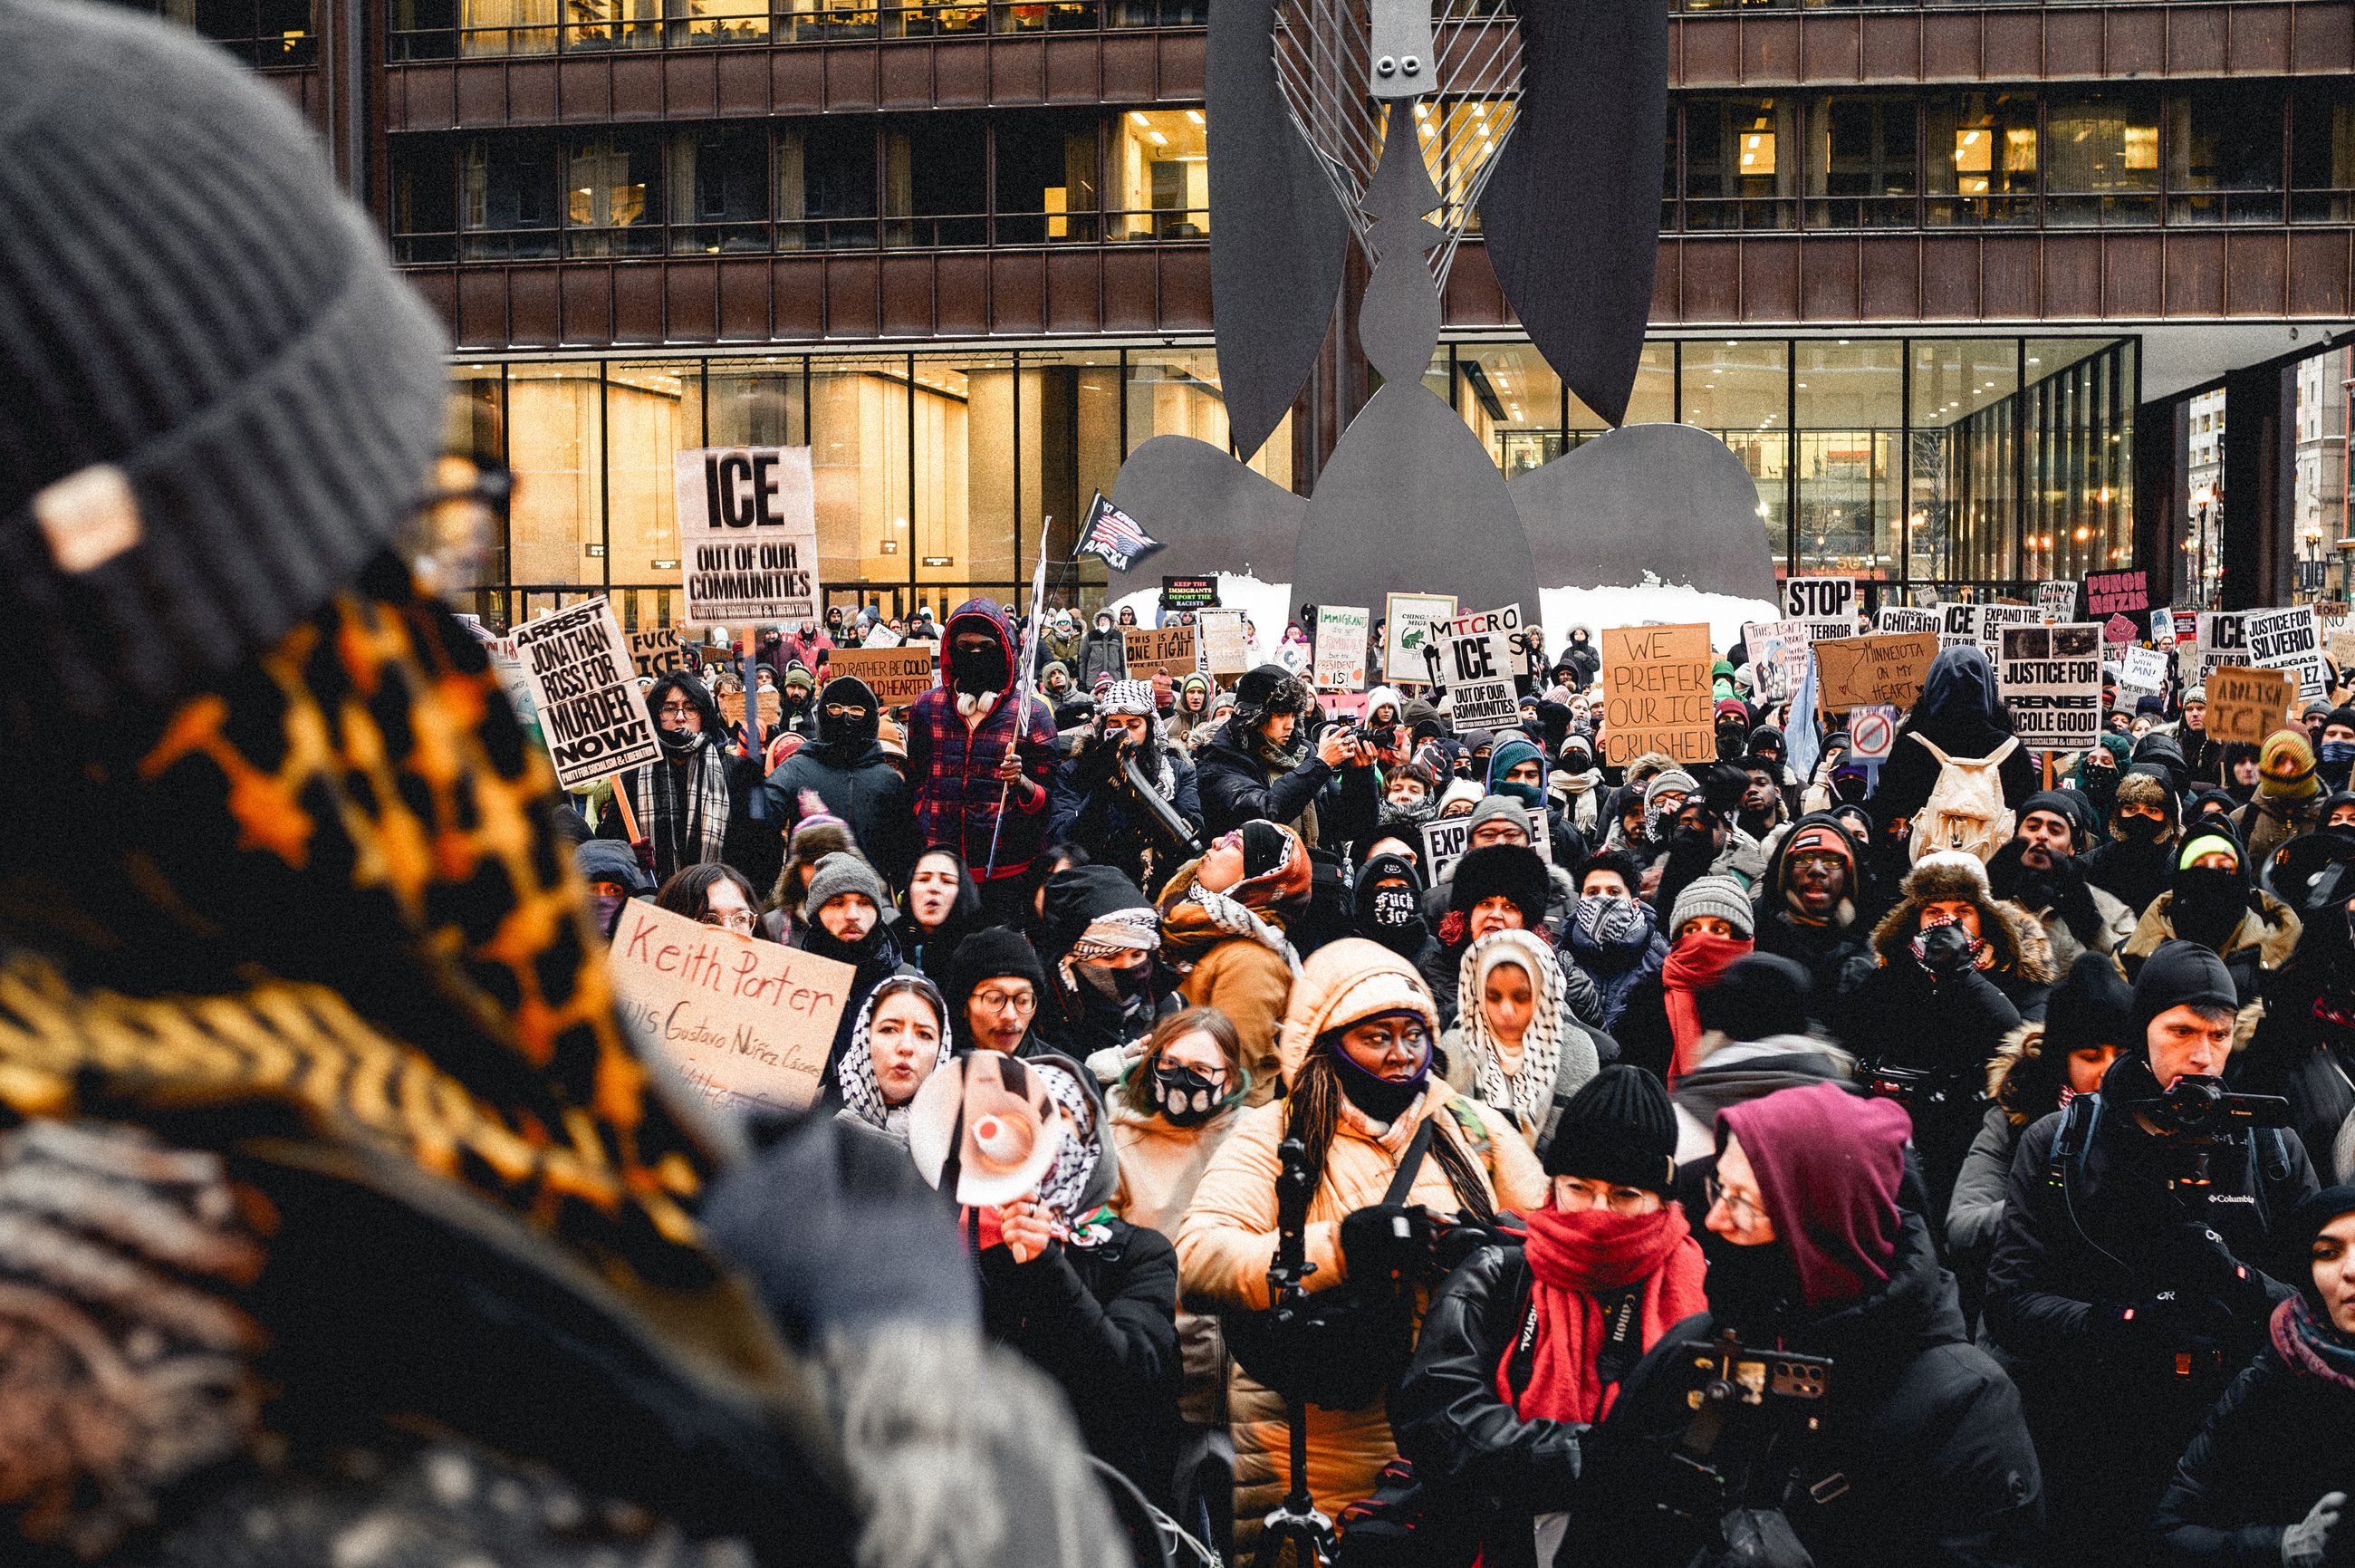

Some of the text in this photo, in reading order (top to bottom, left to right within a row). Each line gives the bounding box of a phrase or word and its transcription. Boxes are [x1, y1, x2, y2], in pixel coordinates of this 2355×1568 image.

[705, 451, 785, 528] ICE
[697, 541, 798, 572] OUT OF OUR
[688, 570, 812, 601] COMMUNITIES
[2040, 584, 2075, 596] THINK
[2087, 571, 2147, 595] PUNCH
[1789, 581, 1851, 616] STOP
[2088, 591, 2149, 615] NAZIS
[2323, 605, 2345, 615] OUT
[691, 603, 811, 620] PARTY FOR SOCIALISM & LIBERATION
[1882, 611, 1941, 632] CHICAGO
[1944, 605, 1975, 634] ICE
[1985, 608, 2021, 622] EXPAND
[2023, 609, 2041, 623] THE
[517, 602, 605, 649] ARREST
[1812, 624, 1851, 640] TERROR
[2211, 615, 2246, 649] ICE
[2249, 618, 2289, 638] JUSTICE
[2289, 610, 2312, 628] FOR
[531, 621, 612, 675] JONATHAN
[632, 629, 679, 652] FUCK
[1128, 630, 1194, 644] THIS IS ALL
[1623, 631, 1673, 660] WE
[1943, 638, 1952, 647] UT
[2103, 640, 2126, 651] hicago
[2251, 627, 2315, 660] SILVERIO
[1127, 645, 1150, 661] ONE
[1158, 640, 1192, 659] FIGHT
[1452, 636, 1497, 681] ICE
[1864, 640, 1925, 663] MINNESOTA
[2139, 650, 2163, 660] STAND
[2205, 655, 2225, 667] OUT
[2225, 655, 2235, 667] OF
[635, 650, 679, 678] ICE
[830, 659, 930, 678] I'D RATHER BE COLD
[1317, 659, 1356, 670] PRESIDENT
[1897, 664, 1913, 677] MY
[2004, 661, 2067, 684] JUSTICE
[2068, 661, 2098, 684] FOR
[540, 653, 620, 704] ROSS FOR
[866, 680, 886, 697] OLD
[1614, 663, 1707, 693] PREFER
[1455, 684, 1506, 704] OUT OF OUR
[1871, 681, 1914, 701] HEART
[2004, 695, 2098, 709] RENEE
[546, 684, 637, 744] MURDER
[1453, 698, 1515, 719] COMMUNITIES
[1608, 695, 1711, 726] OUR ICE
[2013, 712, 2097, 732] ICOLE GOOD
[553, 719, 650, 767] NOW!
[1609, 731, 1712, 763] CRUSHED.
[2032, 737, 2059, 746] SOCIALISM
[2066, 736, 2095, 746] LIBERATION
[562, 768, 579, 783] PARTY
[616, 755, 625, 765] &
[1375, 892, 1414, 910] Fuck
[627, 915, 834, 1016] Keith Porter
[2217, 1195, 2254, 1206] Columbia
[2157, 1291, 2175, 1301] OR
[1520, 1303, 1538, 1352] IGITAL
[1612, 1294, 1636, 1342] Canon
